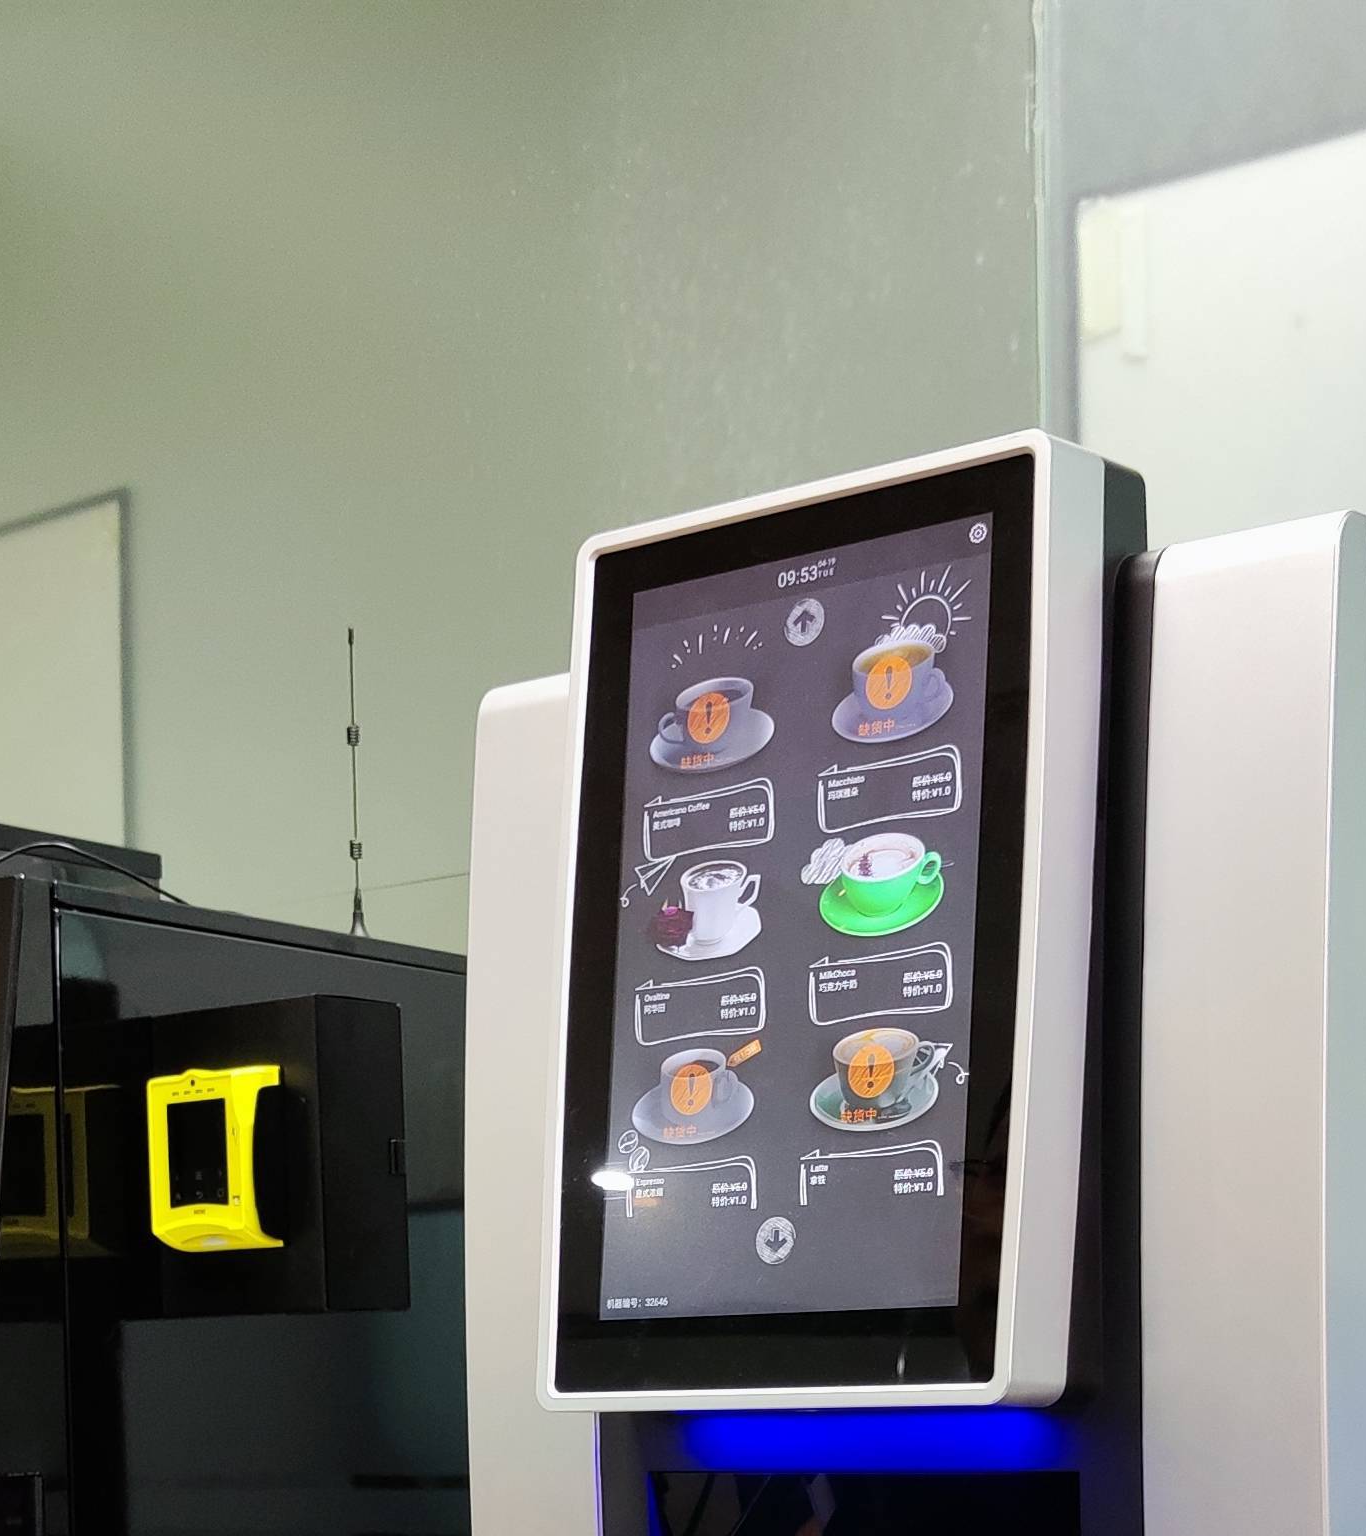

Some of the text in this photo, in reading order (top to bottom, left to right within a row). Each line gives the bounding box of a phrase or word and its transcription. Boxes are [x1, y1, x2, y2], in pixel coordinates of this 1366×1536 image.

[777, 564, 818, 588] 09:53
[818, 567, 835, 579] TUE
[827, 775, 866, 788] Macchiato
[652, 802, 710, 819] Americano Coffee
[818, 979, 858, 993] 巧克力牛奶
